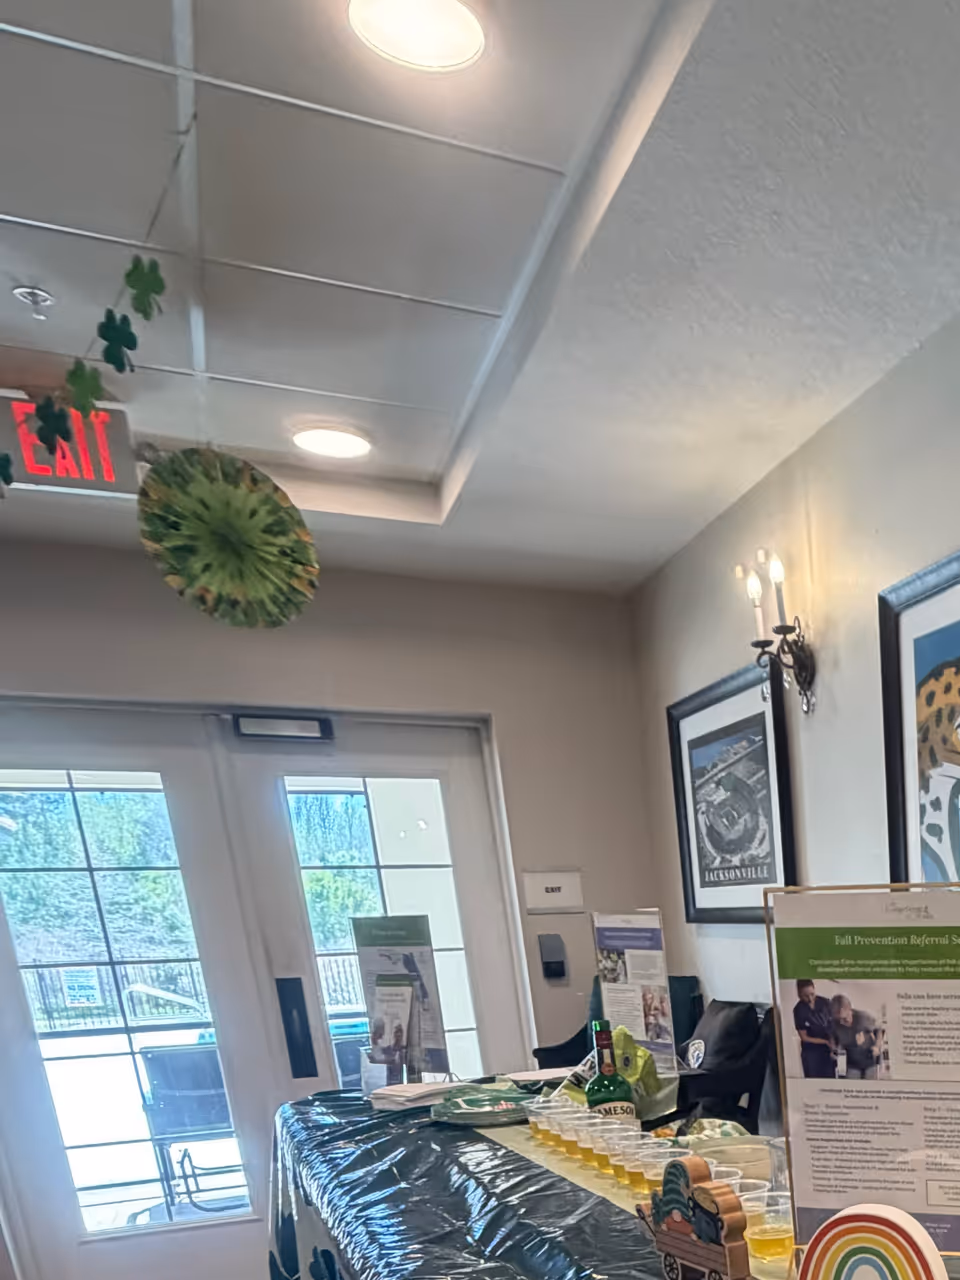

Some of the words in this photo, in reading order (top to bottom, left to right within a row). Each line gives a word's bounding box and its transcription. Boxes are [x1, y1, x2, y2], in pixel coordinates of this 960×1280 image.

[704, 866, 769, 882] JACKSONVILLE
[544, 886, 562, 894] EXIT
[834, 935, 851, 946] Fall
[854, 934, 907, 946] Prevention
[910, 934, 949, 947] Referral
[593, 1105, 634, 1117] AMESO
